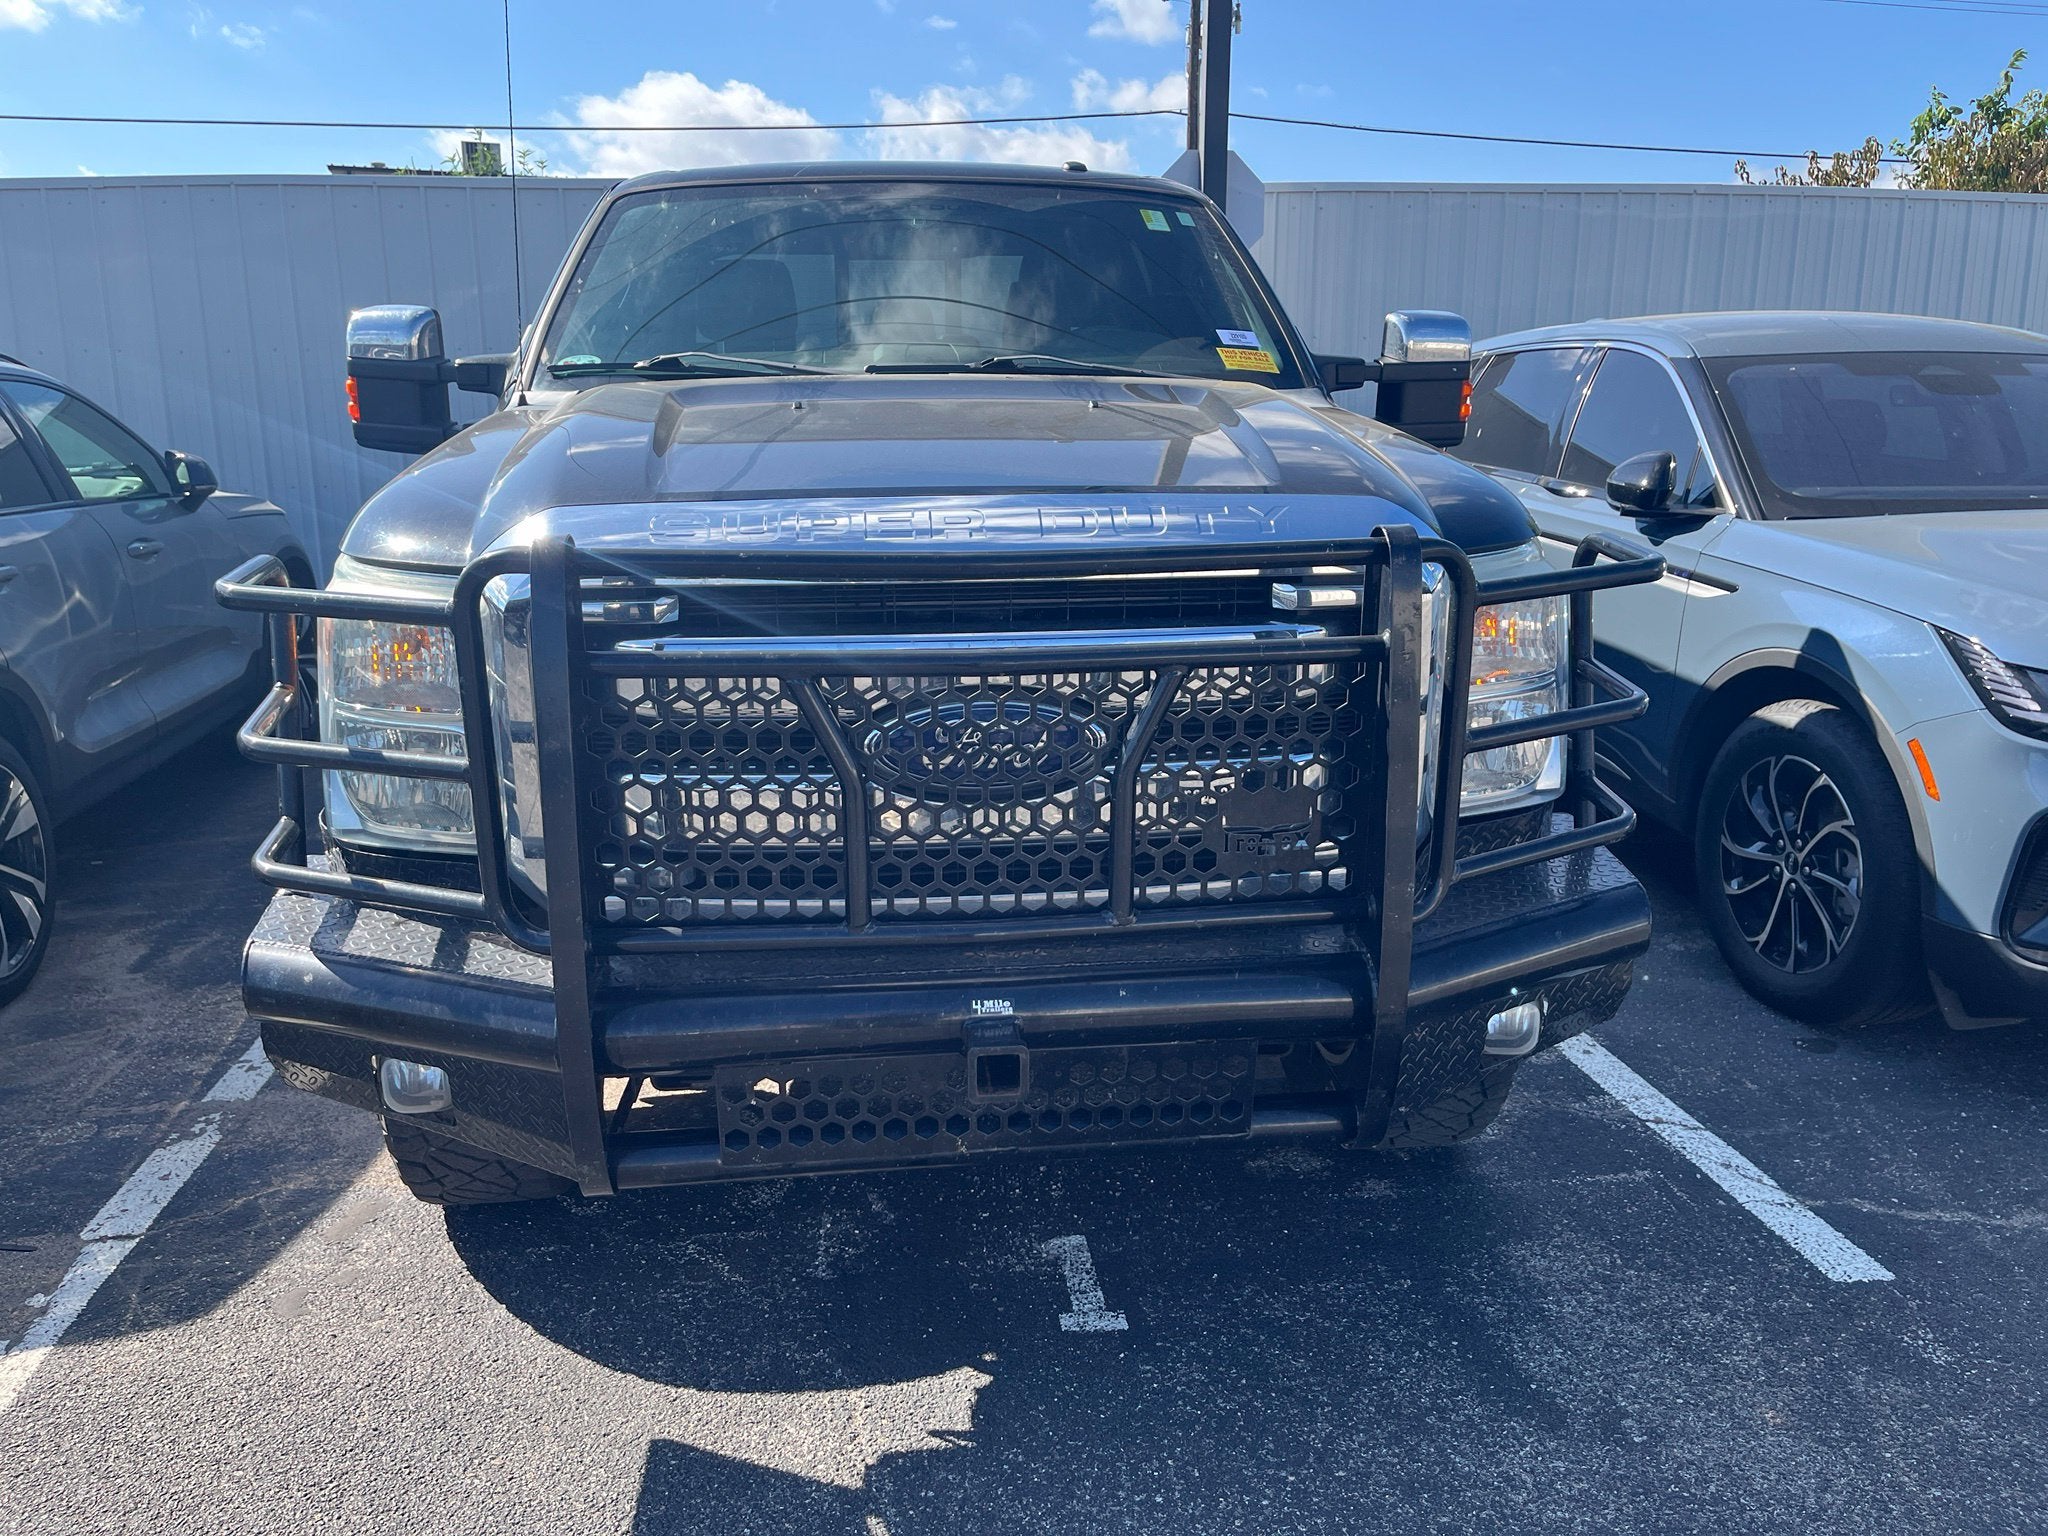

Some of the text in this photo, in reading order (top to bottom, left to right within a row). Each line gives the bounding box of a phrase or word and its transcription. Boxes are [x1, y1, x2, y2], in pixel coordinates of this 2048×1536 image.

[1239, 350, 1270, 359] VEHICLE
[649, 505, 1290, 544] SUPER DUTY
[972, 999, 1011, 1015] 4 Mile
[1042, 1234, 1129, 1331] 1
